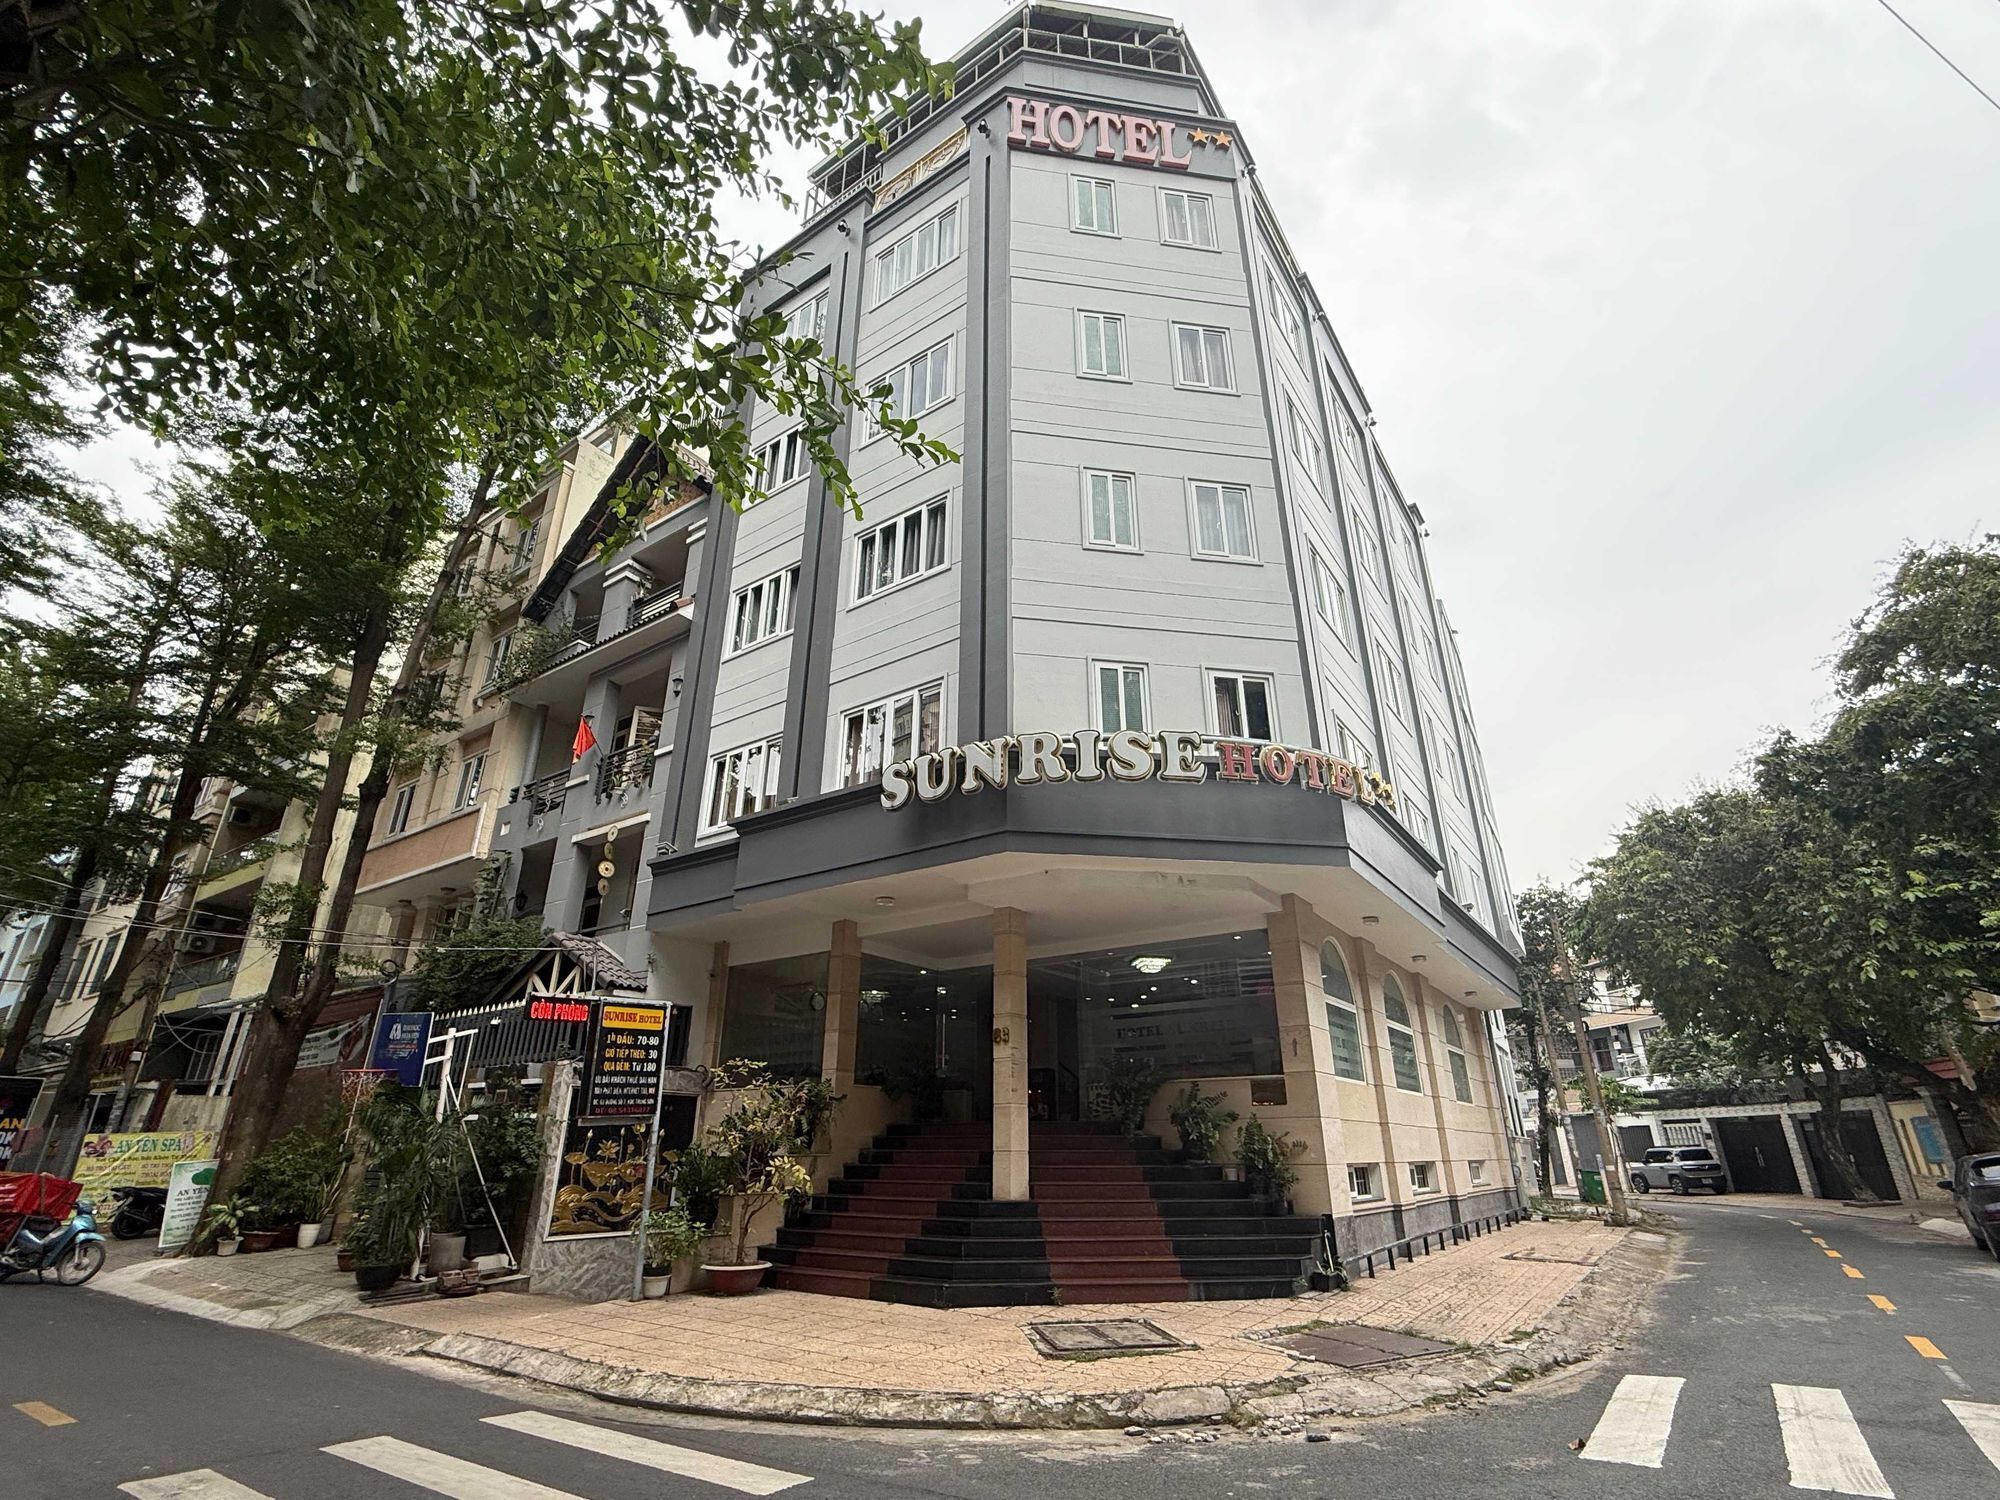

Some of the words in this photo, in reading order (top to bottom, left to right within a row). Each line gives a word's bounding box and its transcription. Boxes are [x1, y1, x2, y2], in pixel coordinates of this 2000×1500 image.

[1007, 97, 1192, 170] HOTEL
[880, 729, 1207, 810] SUNRISE
[1215, 741, 1375, 807] HOTEL
[531, 998, 552, 1019] CÒN
[554, 1001, 588, 1021] PHÒNG
[603, 1011, 638, 1022] SUNRISE
[639, 1014, 662, 1025] HOTEL
[637, 1035, 659, 1046] 70-80
[648, 1050, 658, 1059] 30
[643, 1062, 657, 1072] 180
[161, 1138, 182, 1152] SPA
